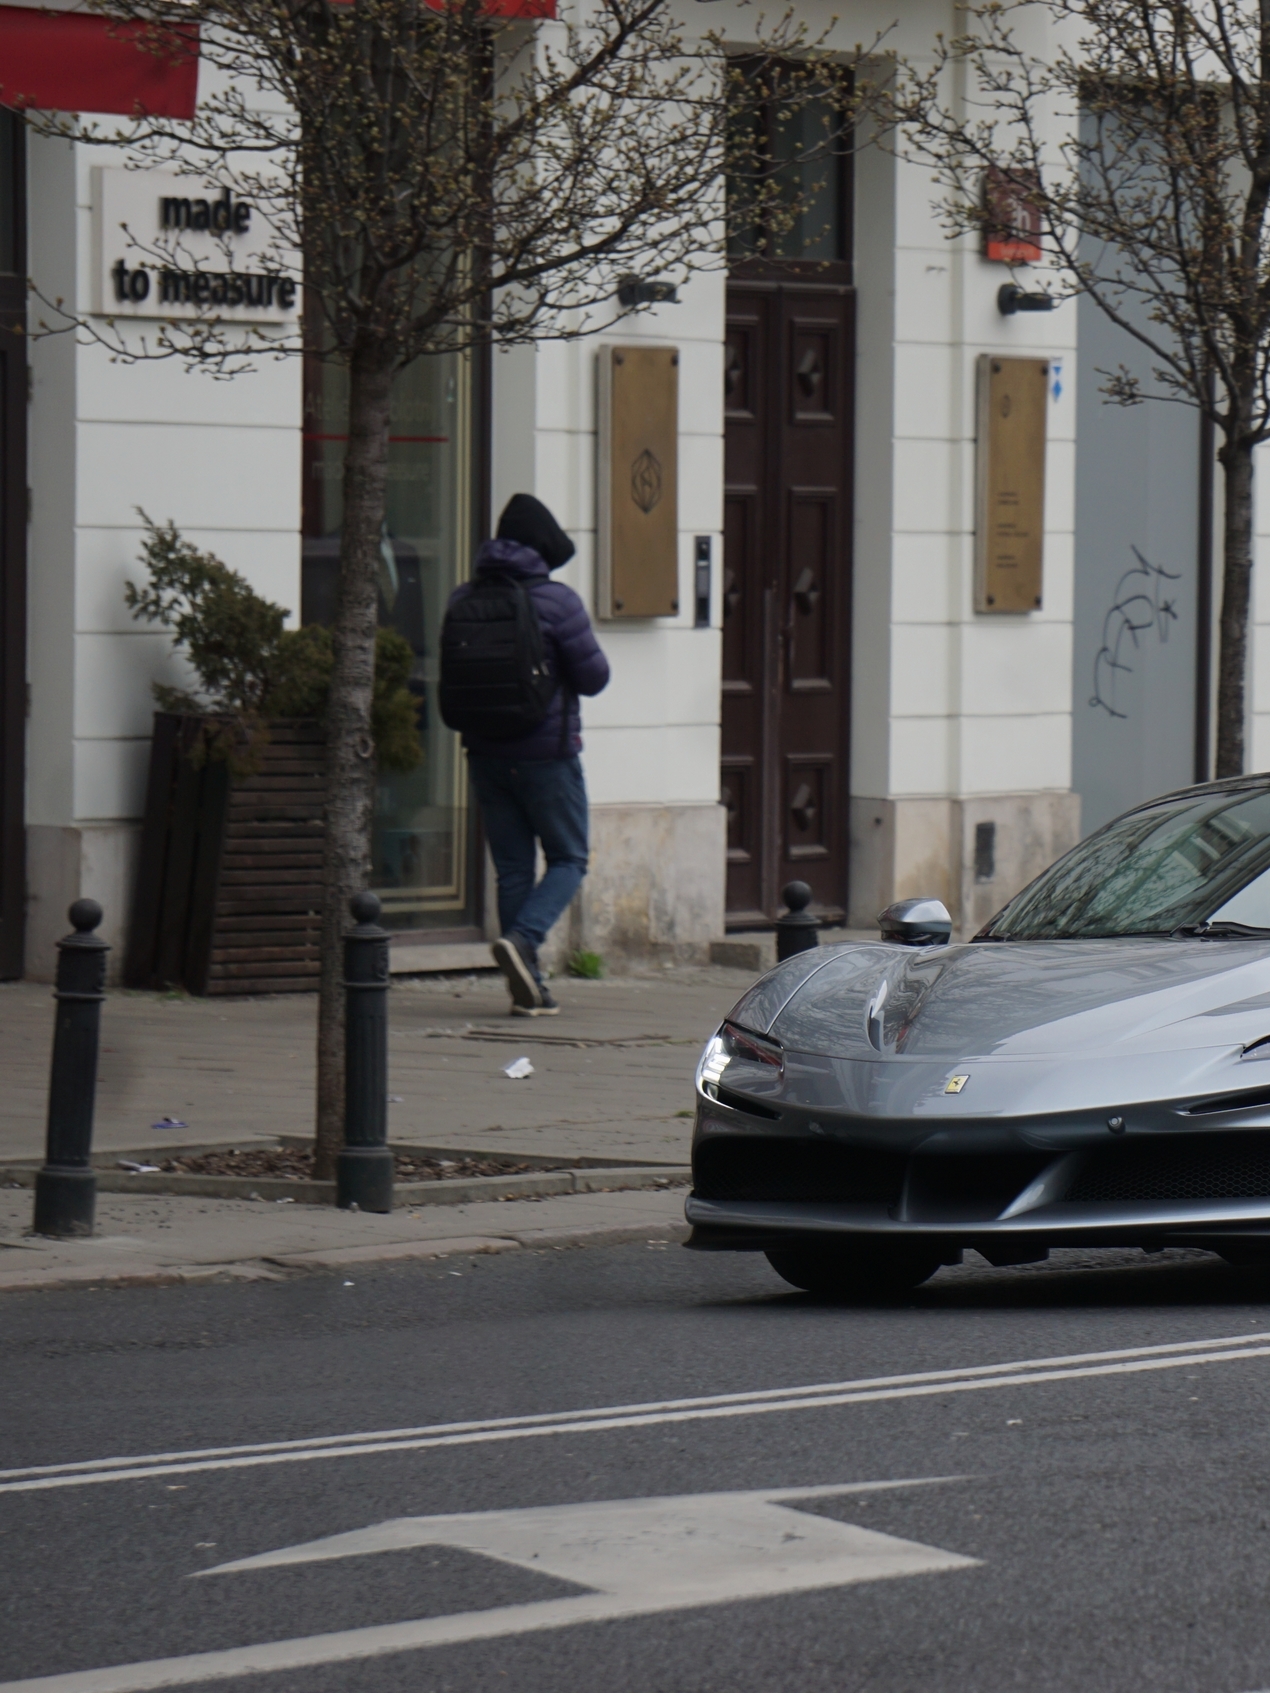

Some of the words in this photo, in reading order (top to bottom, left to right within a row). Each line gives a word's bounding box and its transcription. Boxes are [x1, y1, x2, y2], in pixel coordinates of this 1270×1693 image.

[160, 186, 251, 235] made
[113, 259, 150, 301] to
[158, 270, 297, 309] measure
